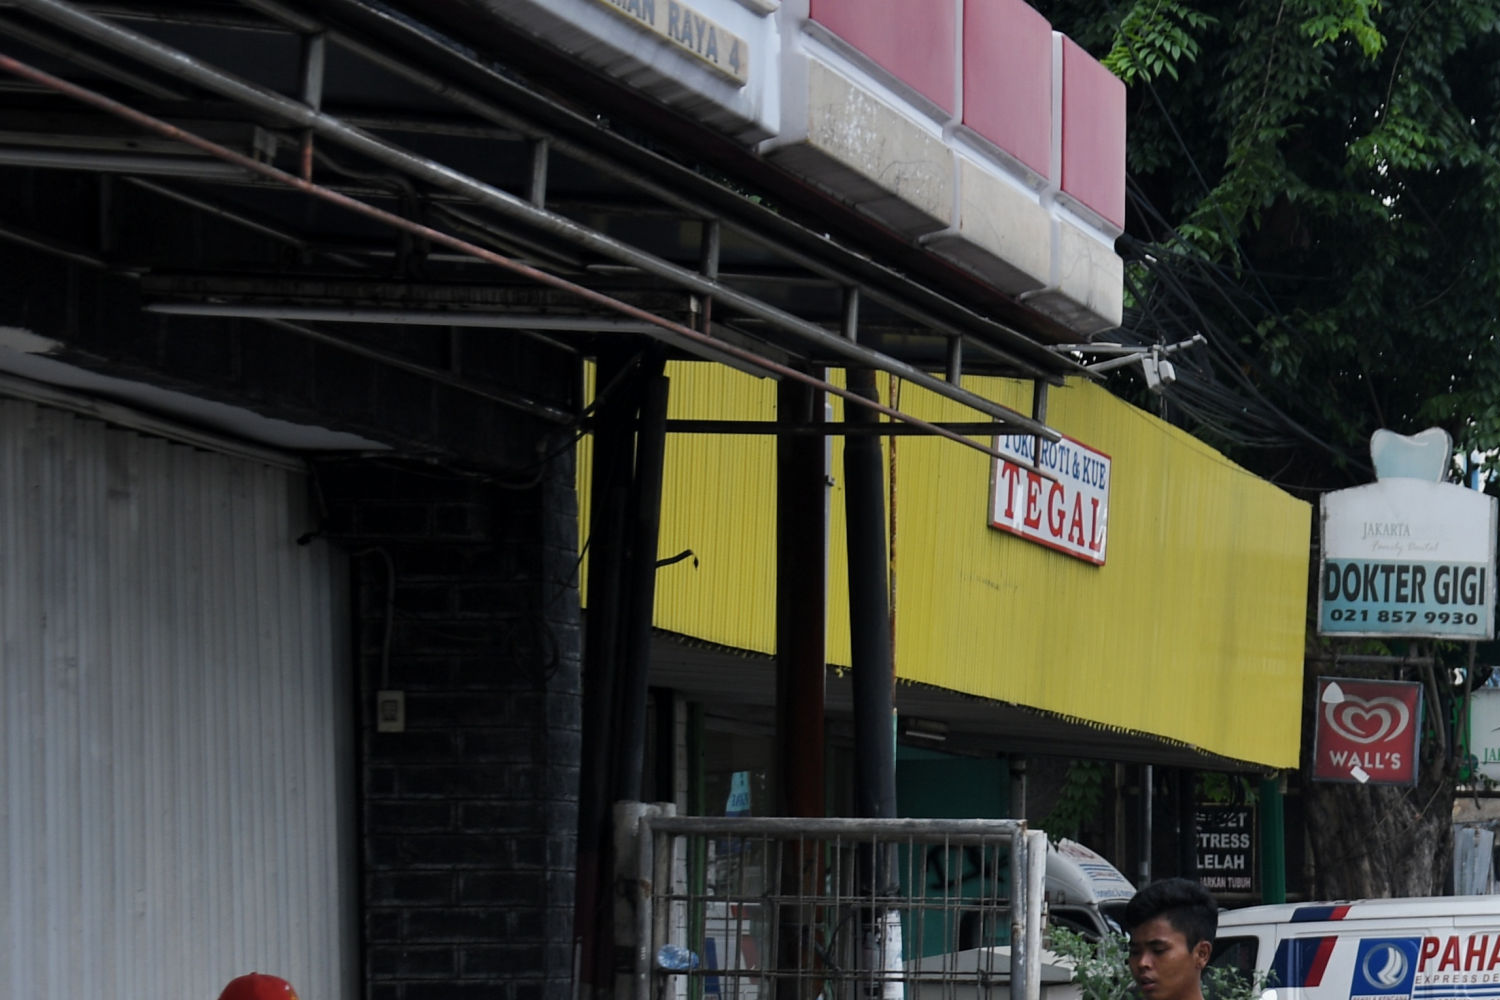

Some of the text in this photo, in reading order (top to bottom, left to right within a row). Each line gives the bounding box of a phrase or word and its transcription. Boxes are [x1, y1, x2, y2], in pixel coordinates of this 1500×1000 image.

[668, 0, 718, 63] RAYA
[729, 40, 740, 74] 4
[1040, 437, 1070, 475] ROTI
[1072, 451, 1080, 480] &
[1083, 455, 1106, 490] KUE
[1002, 461, 1102, 552] TEGAL
[1362, 522, 1410, 539] JAKARTA
[1325, 562, 1486, 606] DOKTER GIGI
[1330, 609, 1478, 625] 021 857 9930
[1329, 750, 1401, 769] WALL'S
[1197, 833, 1250, 848] TRESS
[1197, 854, 1245, 869] LELAH
[1415, 973, 1477, 985] EXPRESS
